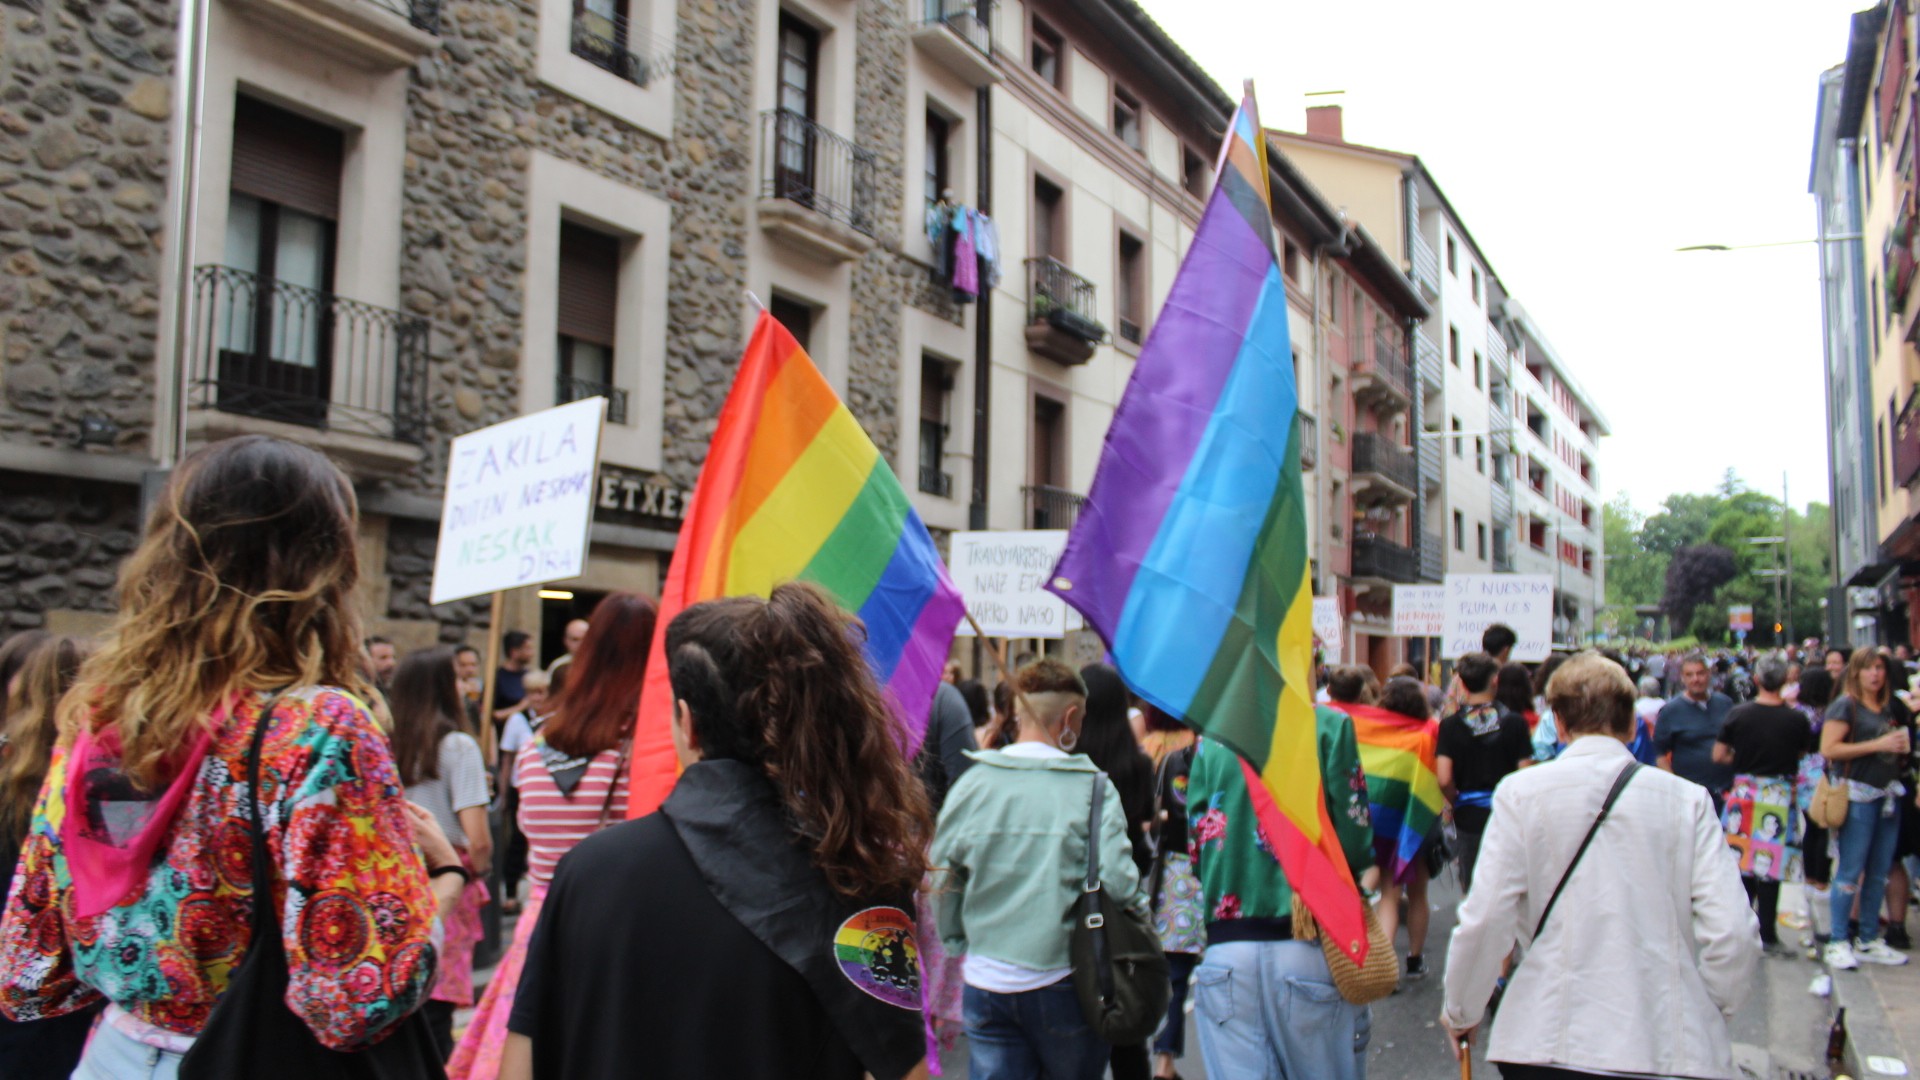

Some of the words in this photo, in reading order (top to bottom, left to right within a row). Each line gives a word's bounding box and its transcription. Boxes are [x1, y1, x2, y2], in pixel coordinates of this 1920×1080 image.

[456, 422, 577, 490] ZAKILA
[1018, 572, 1044, 592] ETA
[1481, 581, 1550, 596] NUESTRA
[1459, 601, 1498, 615] PLUMA
